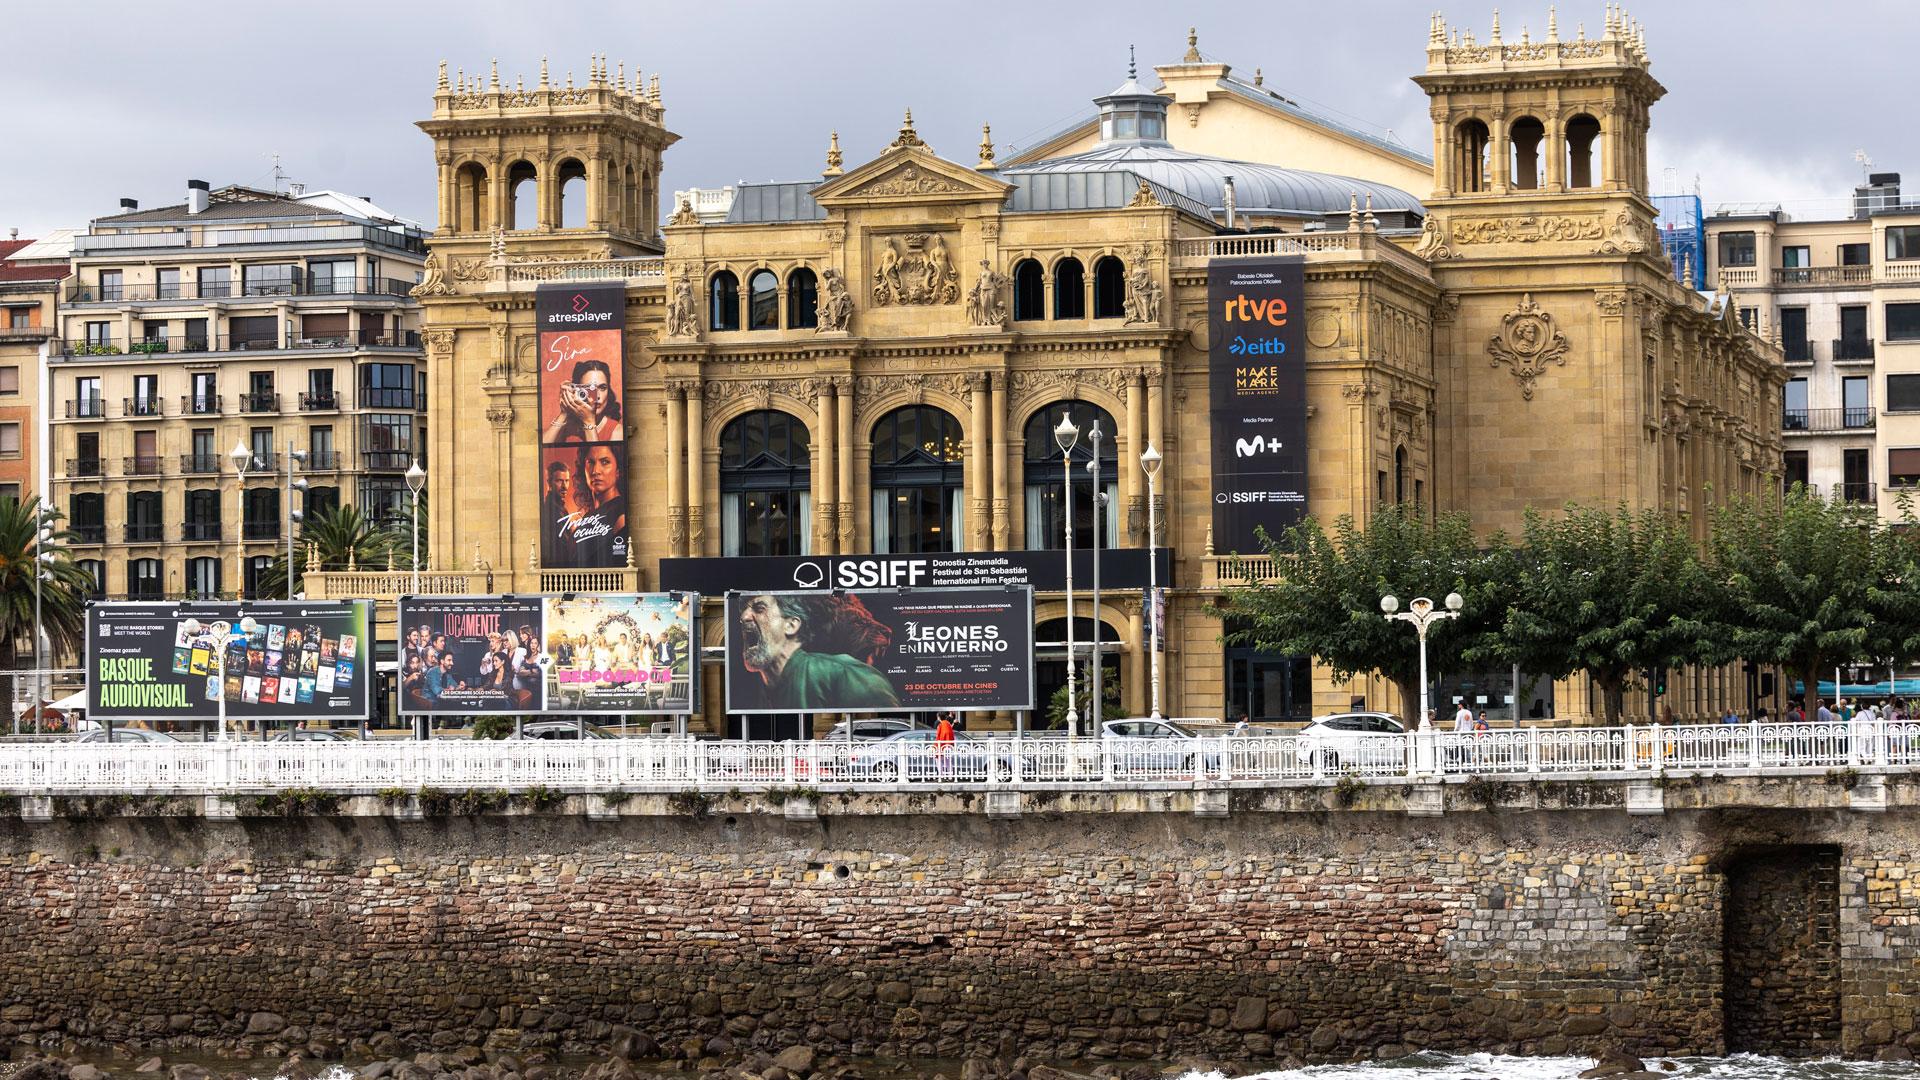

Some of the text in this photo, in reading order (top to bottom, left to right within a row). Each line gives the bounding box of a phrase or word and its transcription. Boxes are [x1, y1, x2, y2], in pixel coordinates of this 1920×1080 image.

[548, 311, 613, 323] atresplayer
[1225, 294, 1288, 327] rtve
[546, 335, 592, 372] Sira
[1247, 337, 1286, 355] eitb
[727, 351, 1111, 375] TEATRO VICTORIA EUGENIA
[1236, 366, 1278, 377] MAKE
[1236, 377, 1278, 388] MARK
[1232, 491, 1267, 503] SSIFF
[556, 511, 608, 538] Trazos
[573, 521, 613, 539] ocultos
[932, 557, 1009, 567] Donostia Zinemaldia
[932, 568, 962, 576] Festival
[974, 567, 989, 575] San
[990, 566, 1028, 575] Sebastián
[837, 559, 927, 587] SSIFF
[932, 575, 1028, 585] International Film Festival
[443, 613, 501, 638] LOCAMENTE
[899, 640, 1008, 654] EN INVIERNO
[540, 657, 549, 665] AF
[99, 658, 157, 683] BASQUE.
[99, 683, 194, 708] AUDIOVISUAL.
